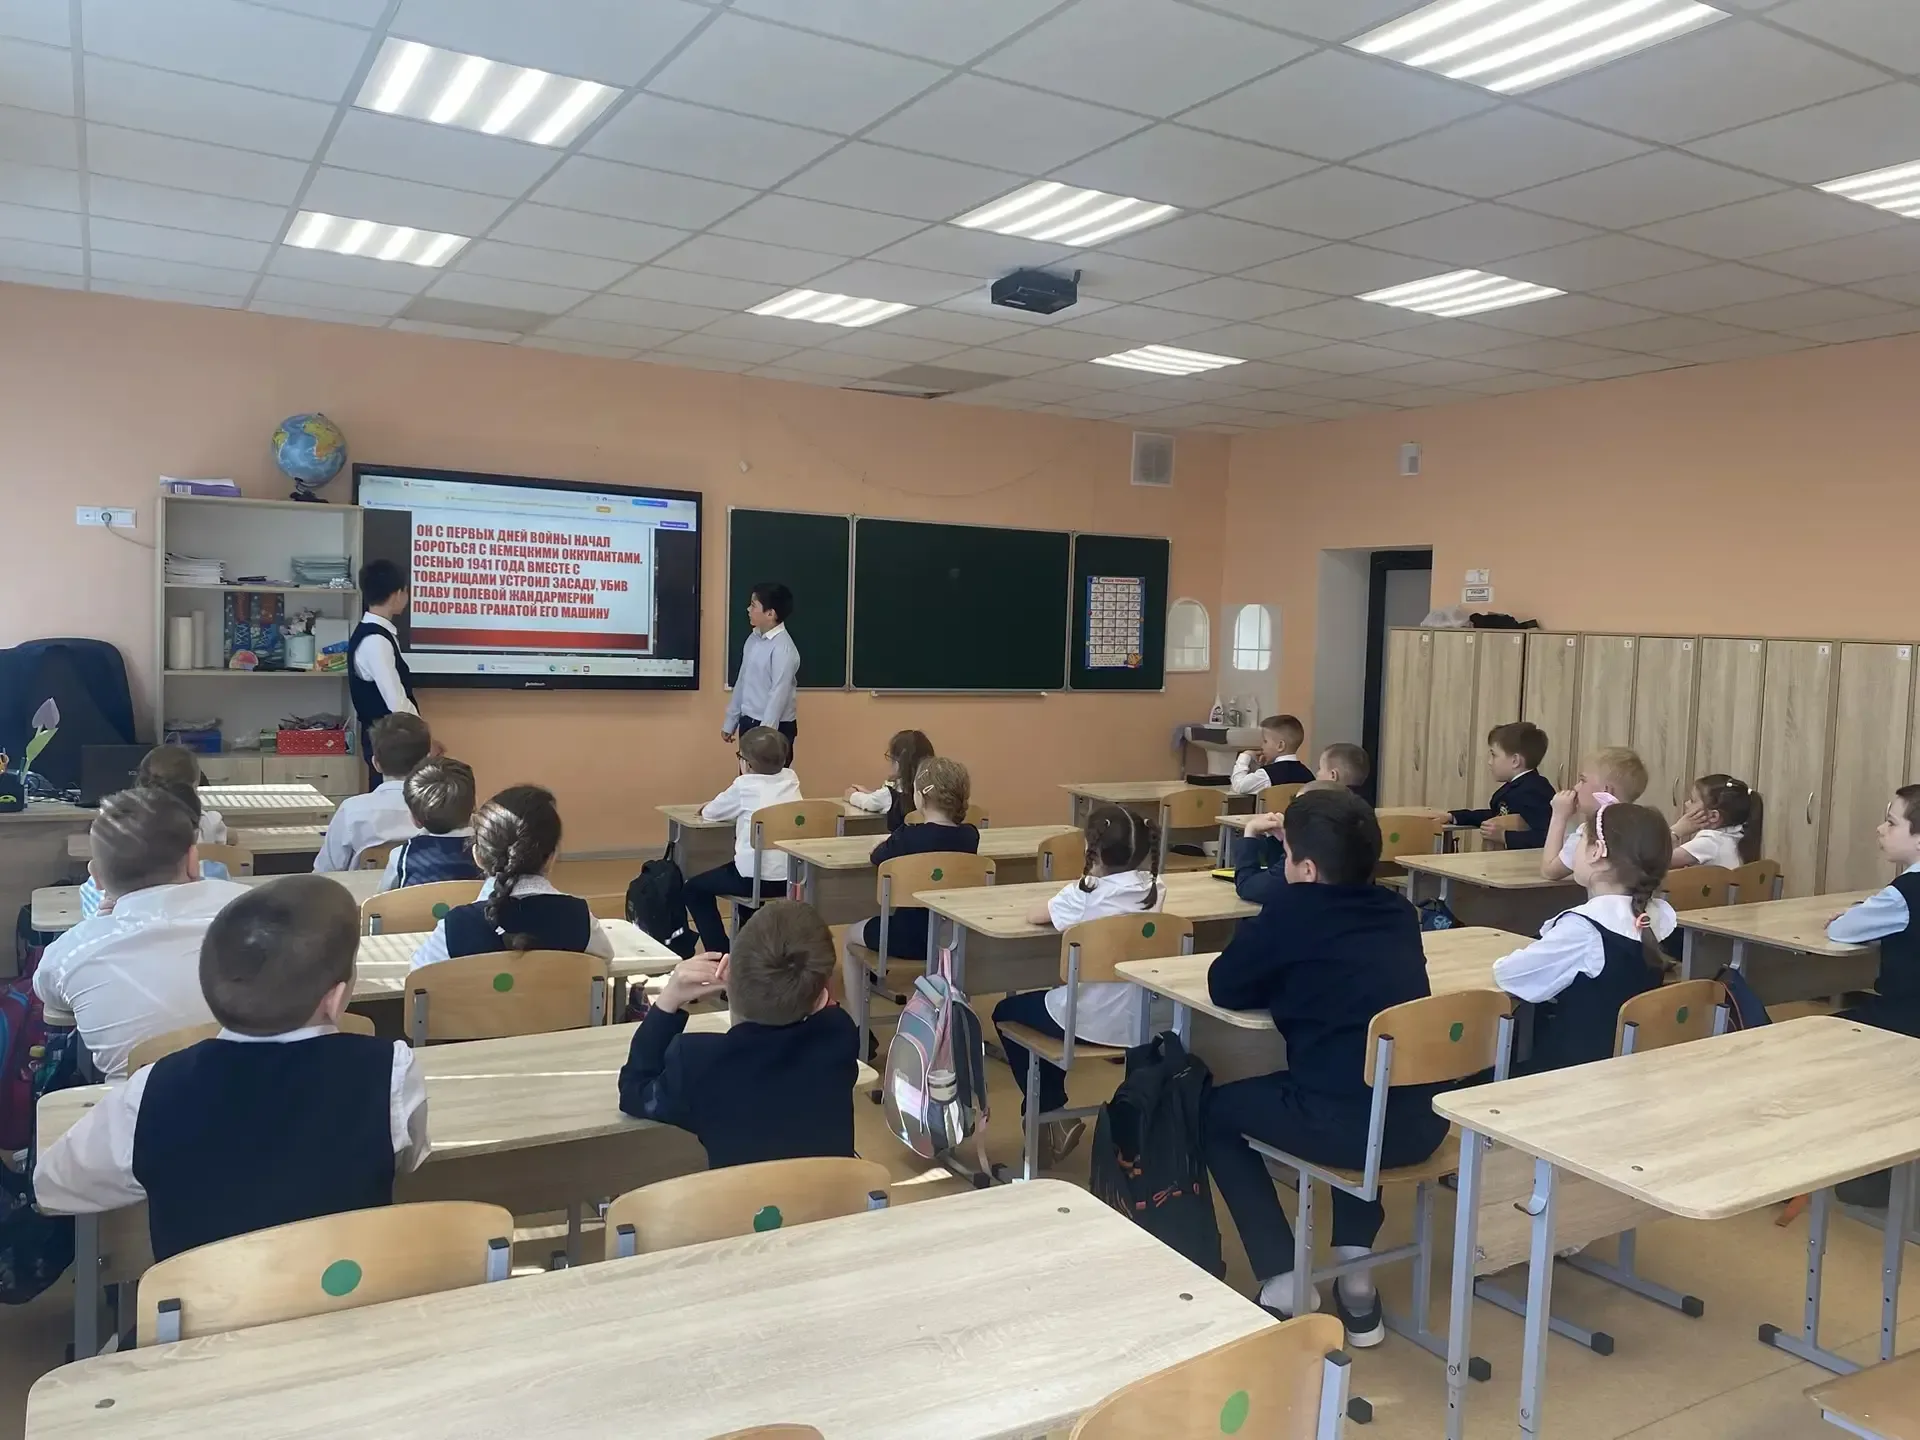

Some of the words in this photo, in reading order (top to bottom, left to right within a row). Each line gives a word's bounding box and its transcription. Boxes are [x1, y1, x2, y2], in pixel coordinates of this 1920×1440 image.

[416, 524, 433, 537] ОН
[435, 525, 444, 537] С
[446, 526, 495, 540] ПЕРВЫХ
[497, 529, 527, 543] ДНЕЙ
[530, 530, 571, 546] ВОЙНЫ
[574, 534, 611, 548] НАЧАЛ
[413, 540, 476, 554] БОРОТЬСЯ
[479, 543, 487, 555] С
[489, 544, 559, 559] НЕМЕЦКИМИ
[562, 548, 643, 564] ОККУПАНТАМИ.
[413, 555, 464, 569] ОСЕНЬЮ
[467, 557, 493, 570] 1941
[495, 559, 525, 573] ГОДА
[527, 561, 570, 574] ВМЕСТЕ
[573, 563, 580, 575] С
[413, 570, 497, 586] ТОВАРИЩАМИ
[499, 574, 550, 588] УСТРОИЛ
[553, 577, 599, 592] ЗАСАДУ,
[600, 579, 628, 592] УБИВ
[413, 585, 450, 599] ГЛАВУ
[453, 587, 506, 601] ПОЛЕВОЙ
[509, 589, 594, 605] ЖАНДАРМЕРИИ
[413, 600, 478, 615] ПОДОРВАВ
[480, 602, 537, 617] ГРАНАТОЙ
[540, 605, 558, 618] ЕГО
[561, 606, 610, 620] МАШИНУ
